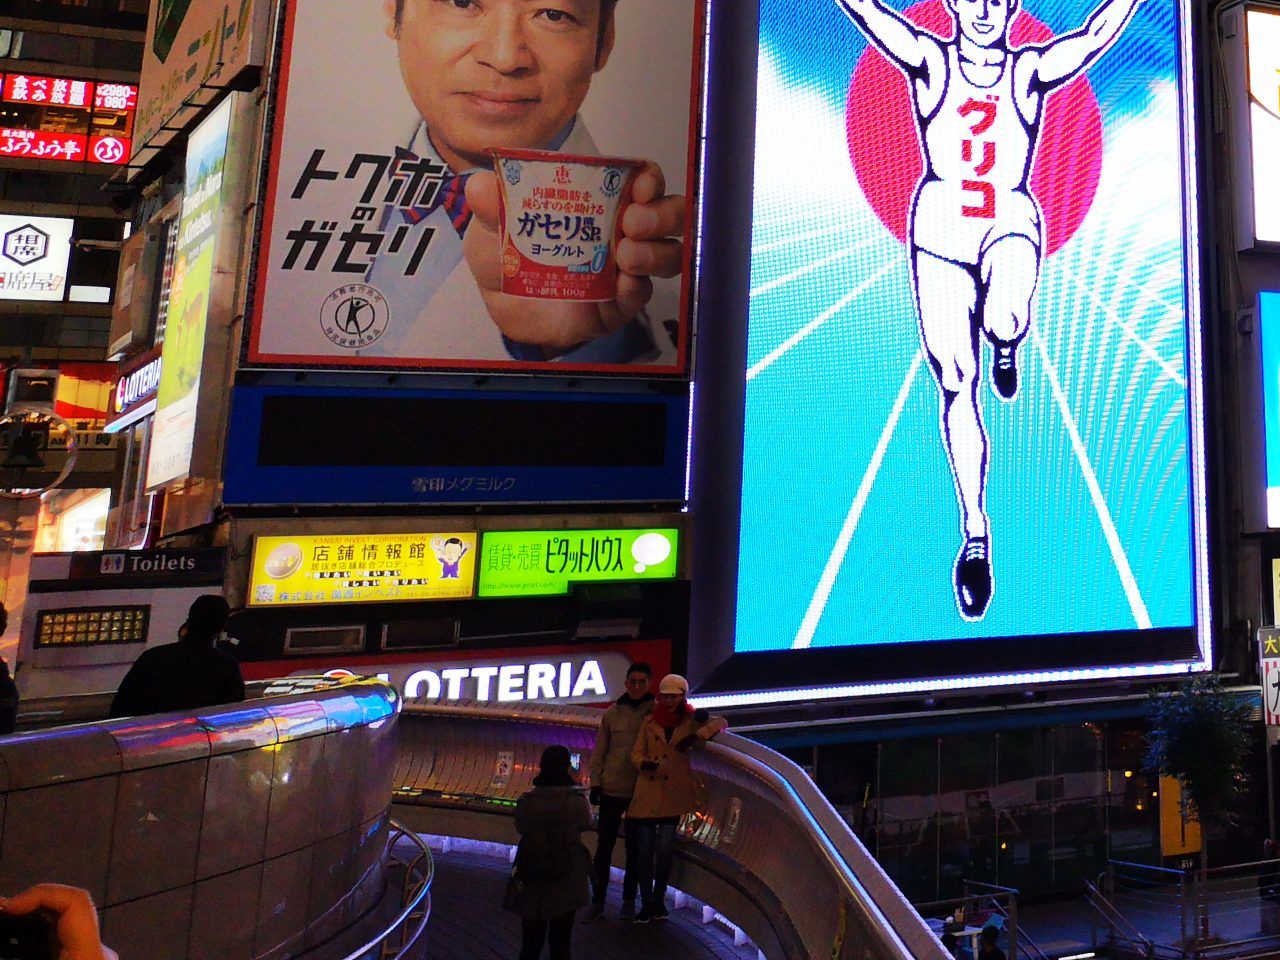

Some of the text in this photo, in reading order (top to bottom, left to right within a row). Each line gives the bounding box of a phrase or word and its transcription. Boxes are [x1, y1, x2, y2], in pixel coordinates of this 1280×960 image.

[957, 94, 1000, 218] グリコ
[291, 148, 447, 211] トクホ
[552, 165, 572, 184] 恵
[532, 187, 593, 203] 内臓脂肪を
[350, 205, 377, 221] の
[521, 197, 605, 216] 減らすのを助ける
[281, 220, 435, 277] ガセリ
[531, 243, 585, 259] ヨーグルト
[0, 271, 54, 291] 席屋
[124, 356, 163, 405] LOTTERIA
[411, 475, 516, 493] 雪印メグミルク
[312, 542, 426, 563] 店舗情報館
[545, 536, 624, 574] ピタットハウス
[131, 554, 196, 572] Toilets
[377, 660, 607, 702] OTTERIA
